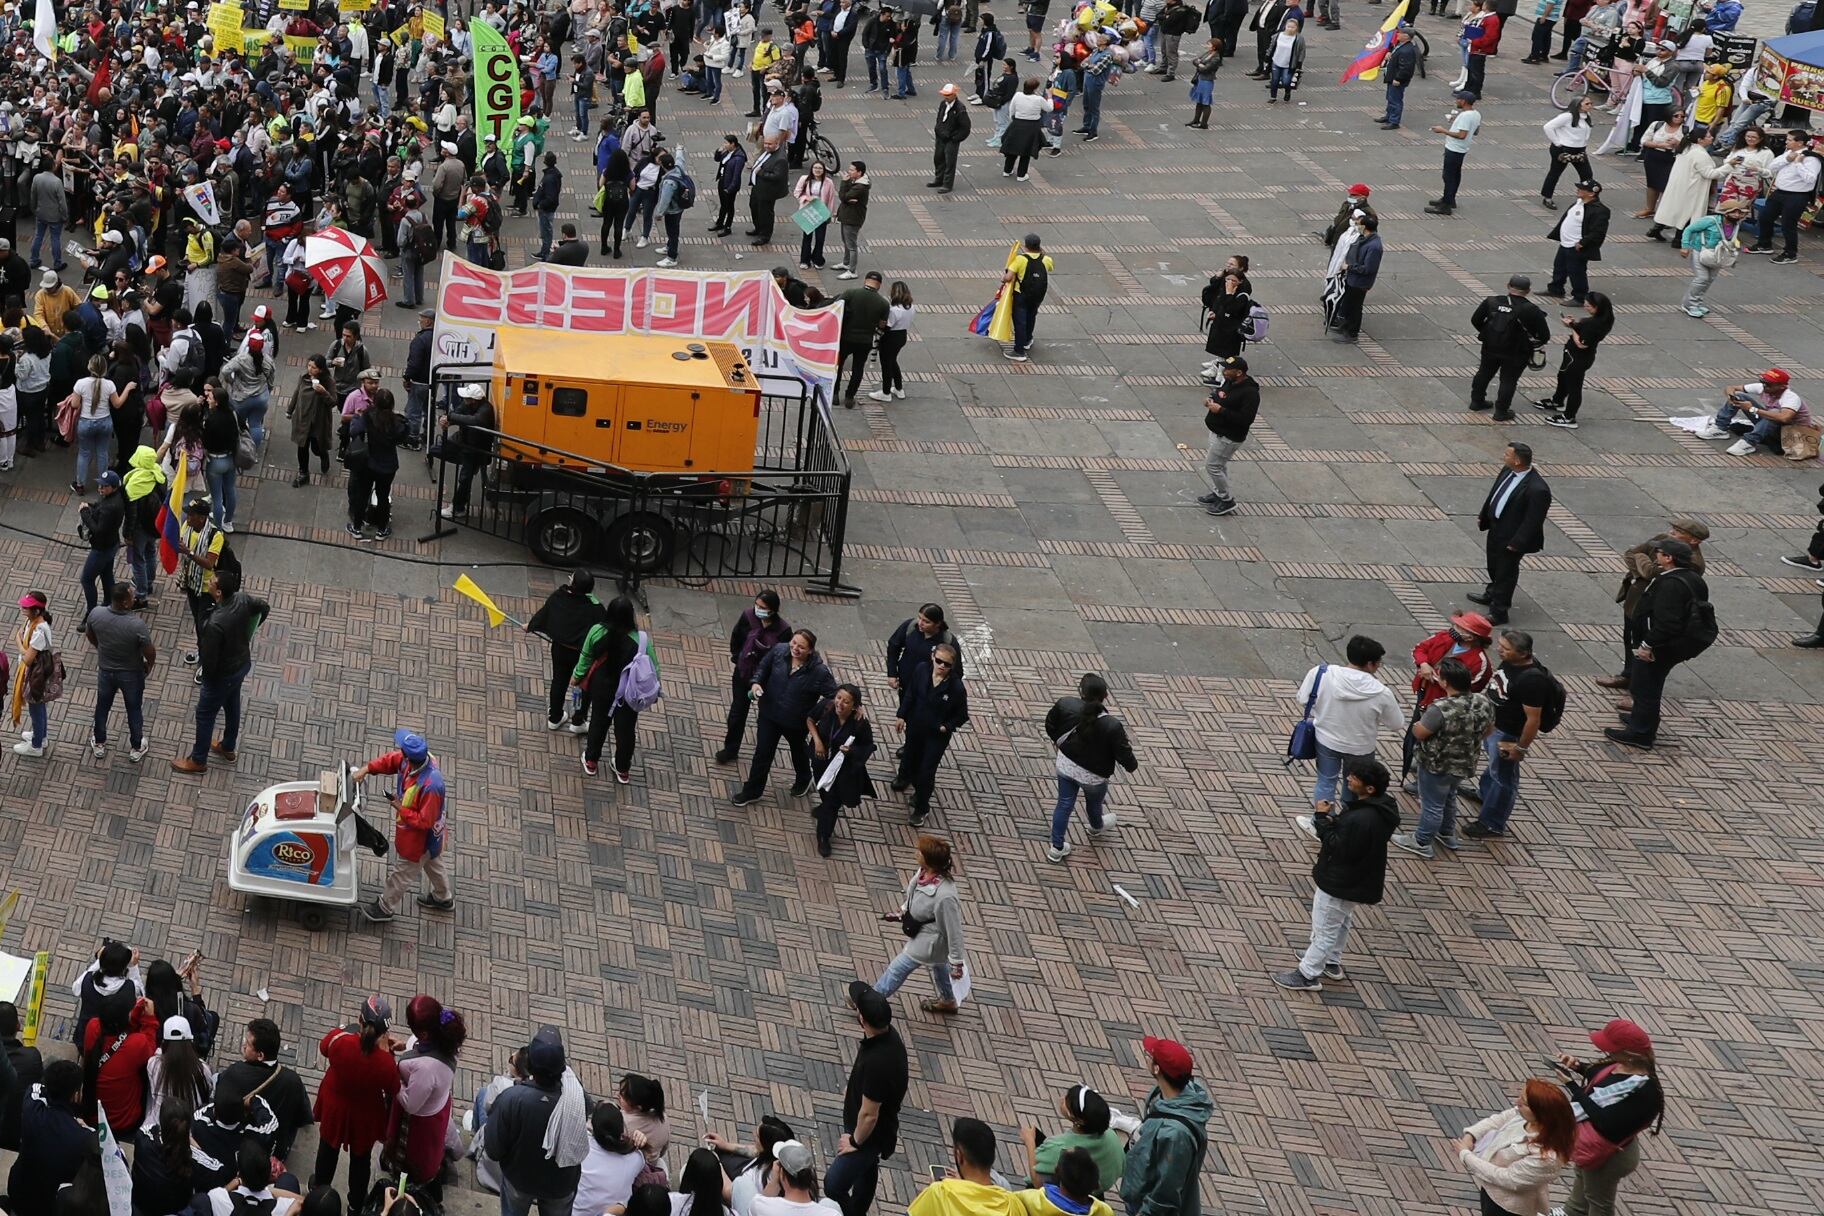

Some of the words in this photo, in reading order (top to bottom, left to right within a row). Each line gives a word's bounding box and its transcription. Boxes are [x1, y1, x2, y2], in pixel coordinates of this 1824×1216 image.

[486, 54, 513, 141] CGT
[1789, 96, 1824, 110] QUESO
[647, 419, 688, 433] Energy
